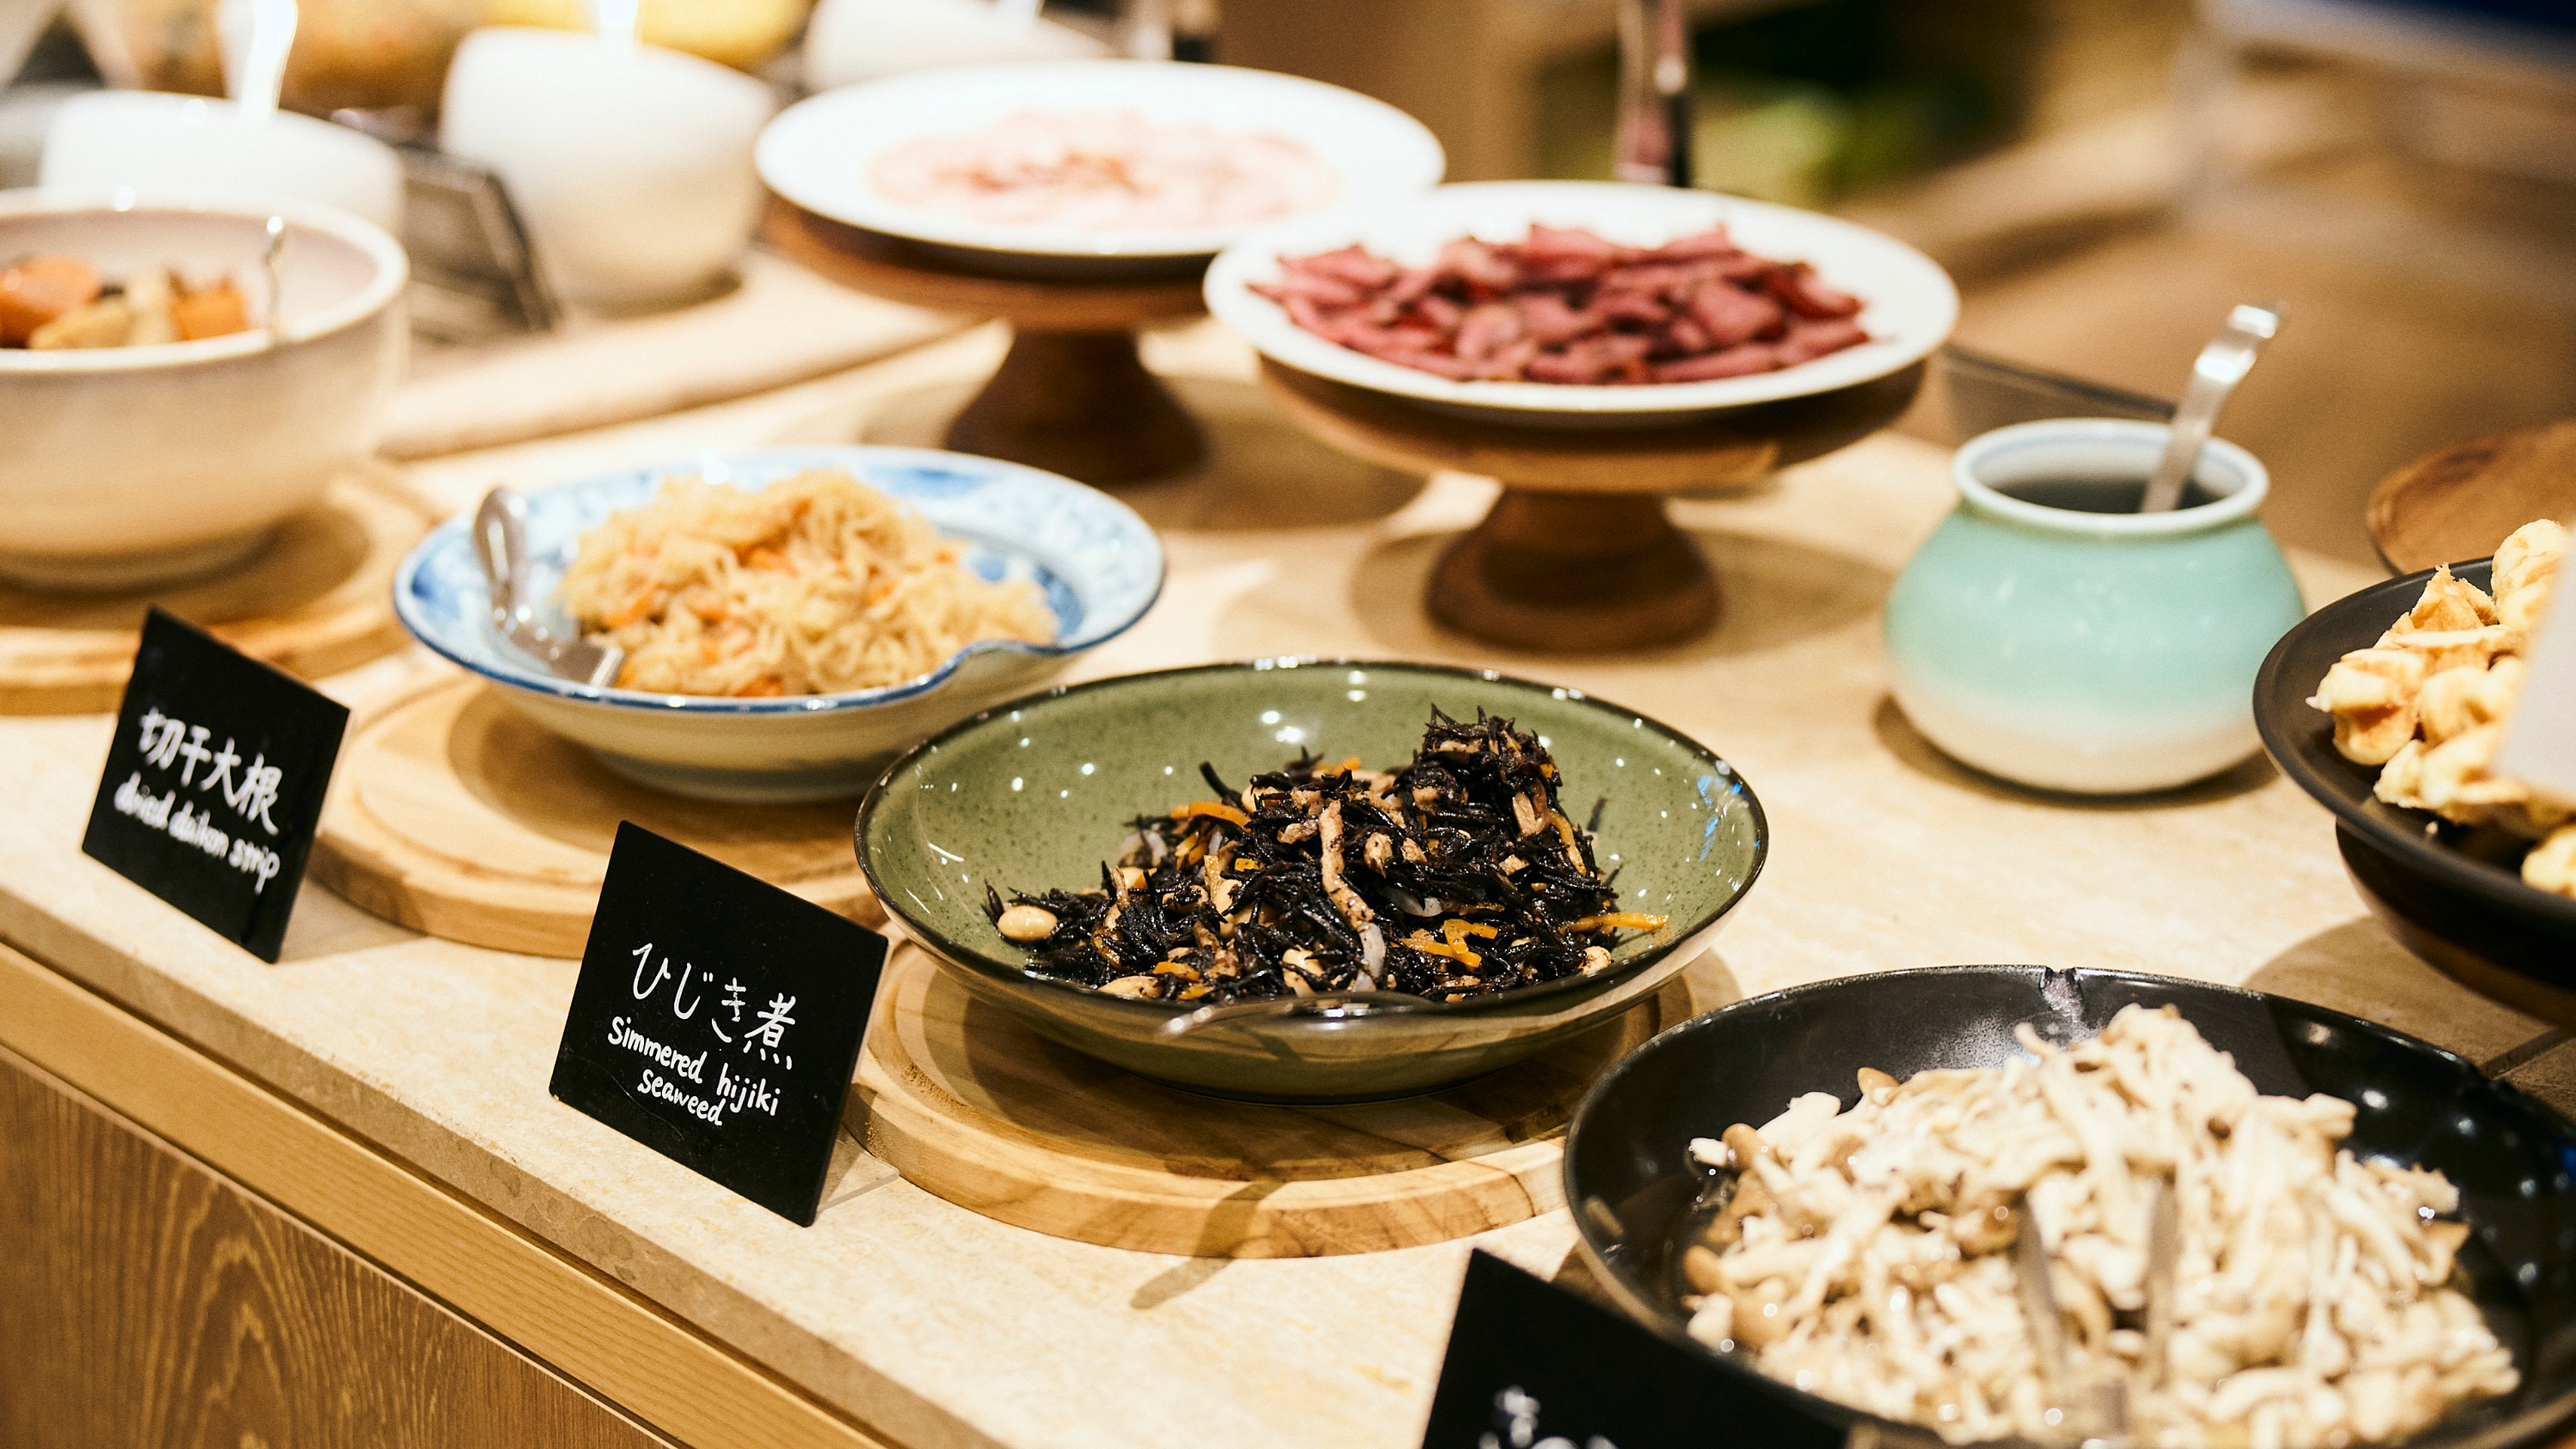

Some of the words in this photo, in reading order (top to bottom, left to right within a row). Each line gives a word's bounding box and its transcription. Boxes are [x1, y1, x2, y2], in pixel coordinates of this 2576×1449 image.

[113, 771, 176, 830] dried
[138, 706, 283, 836] 切干大根
[632, 942, 797, 1070] ひじき煮
[607, 1016, 708, 1084] Simmered
[715, 1062, 782, 1117] hijiki
[636, 1069, 726, 1126] seaweed
